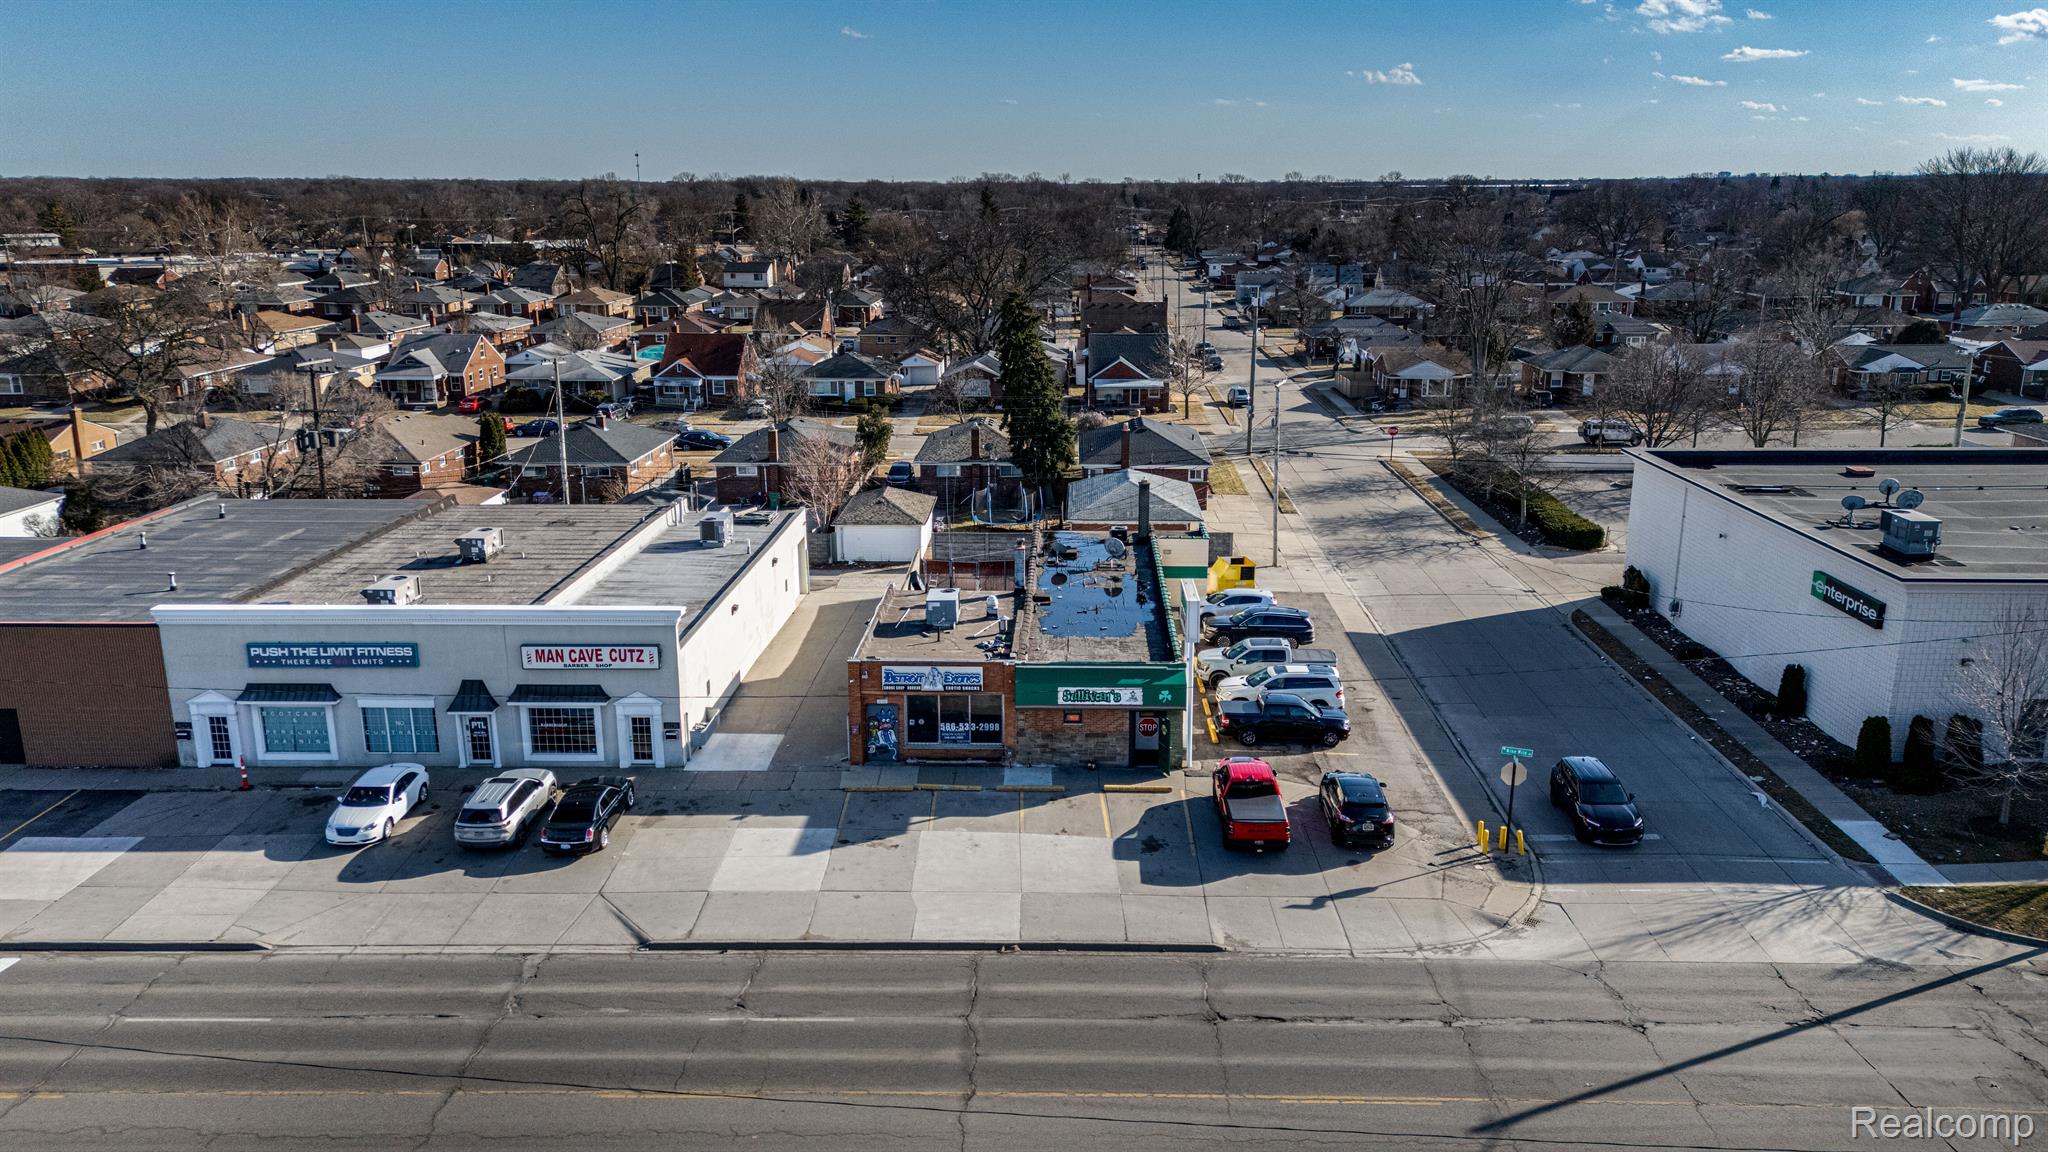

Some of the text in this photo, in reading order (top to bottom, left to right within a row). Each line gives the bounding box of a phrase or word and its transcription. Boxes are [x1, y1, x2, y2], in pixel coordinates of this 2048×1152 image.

[1814, 580, 1876, 620] enterprise
[250, 647, 413, 657] PUSH THE LIMIT FITNESS
[534, 648, 645, 663] MAN CAVE CUTZ
[884, 669, 925, 684] DETROIT
[1062, 689, 1122, 703] Sullivan's
[471, 721, 487, 729] PTL
[1139, 723, 1158, 732] STOP
